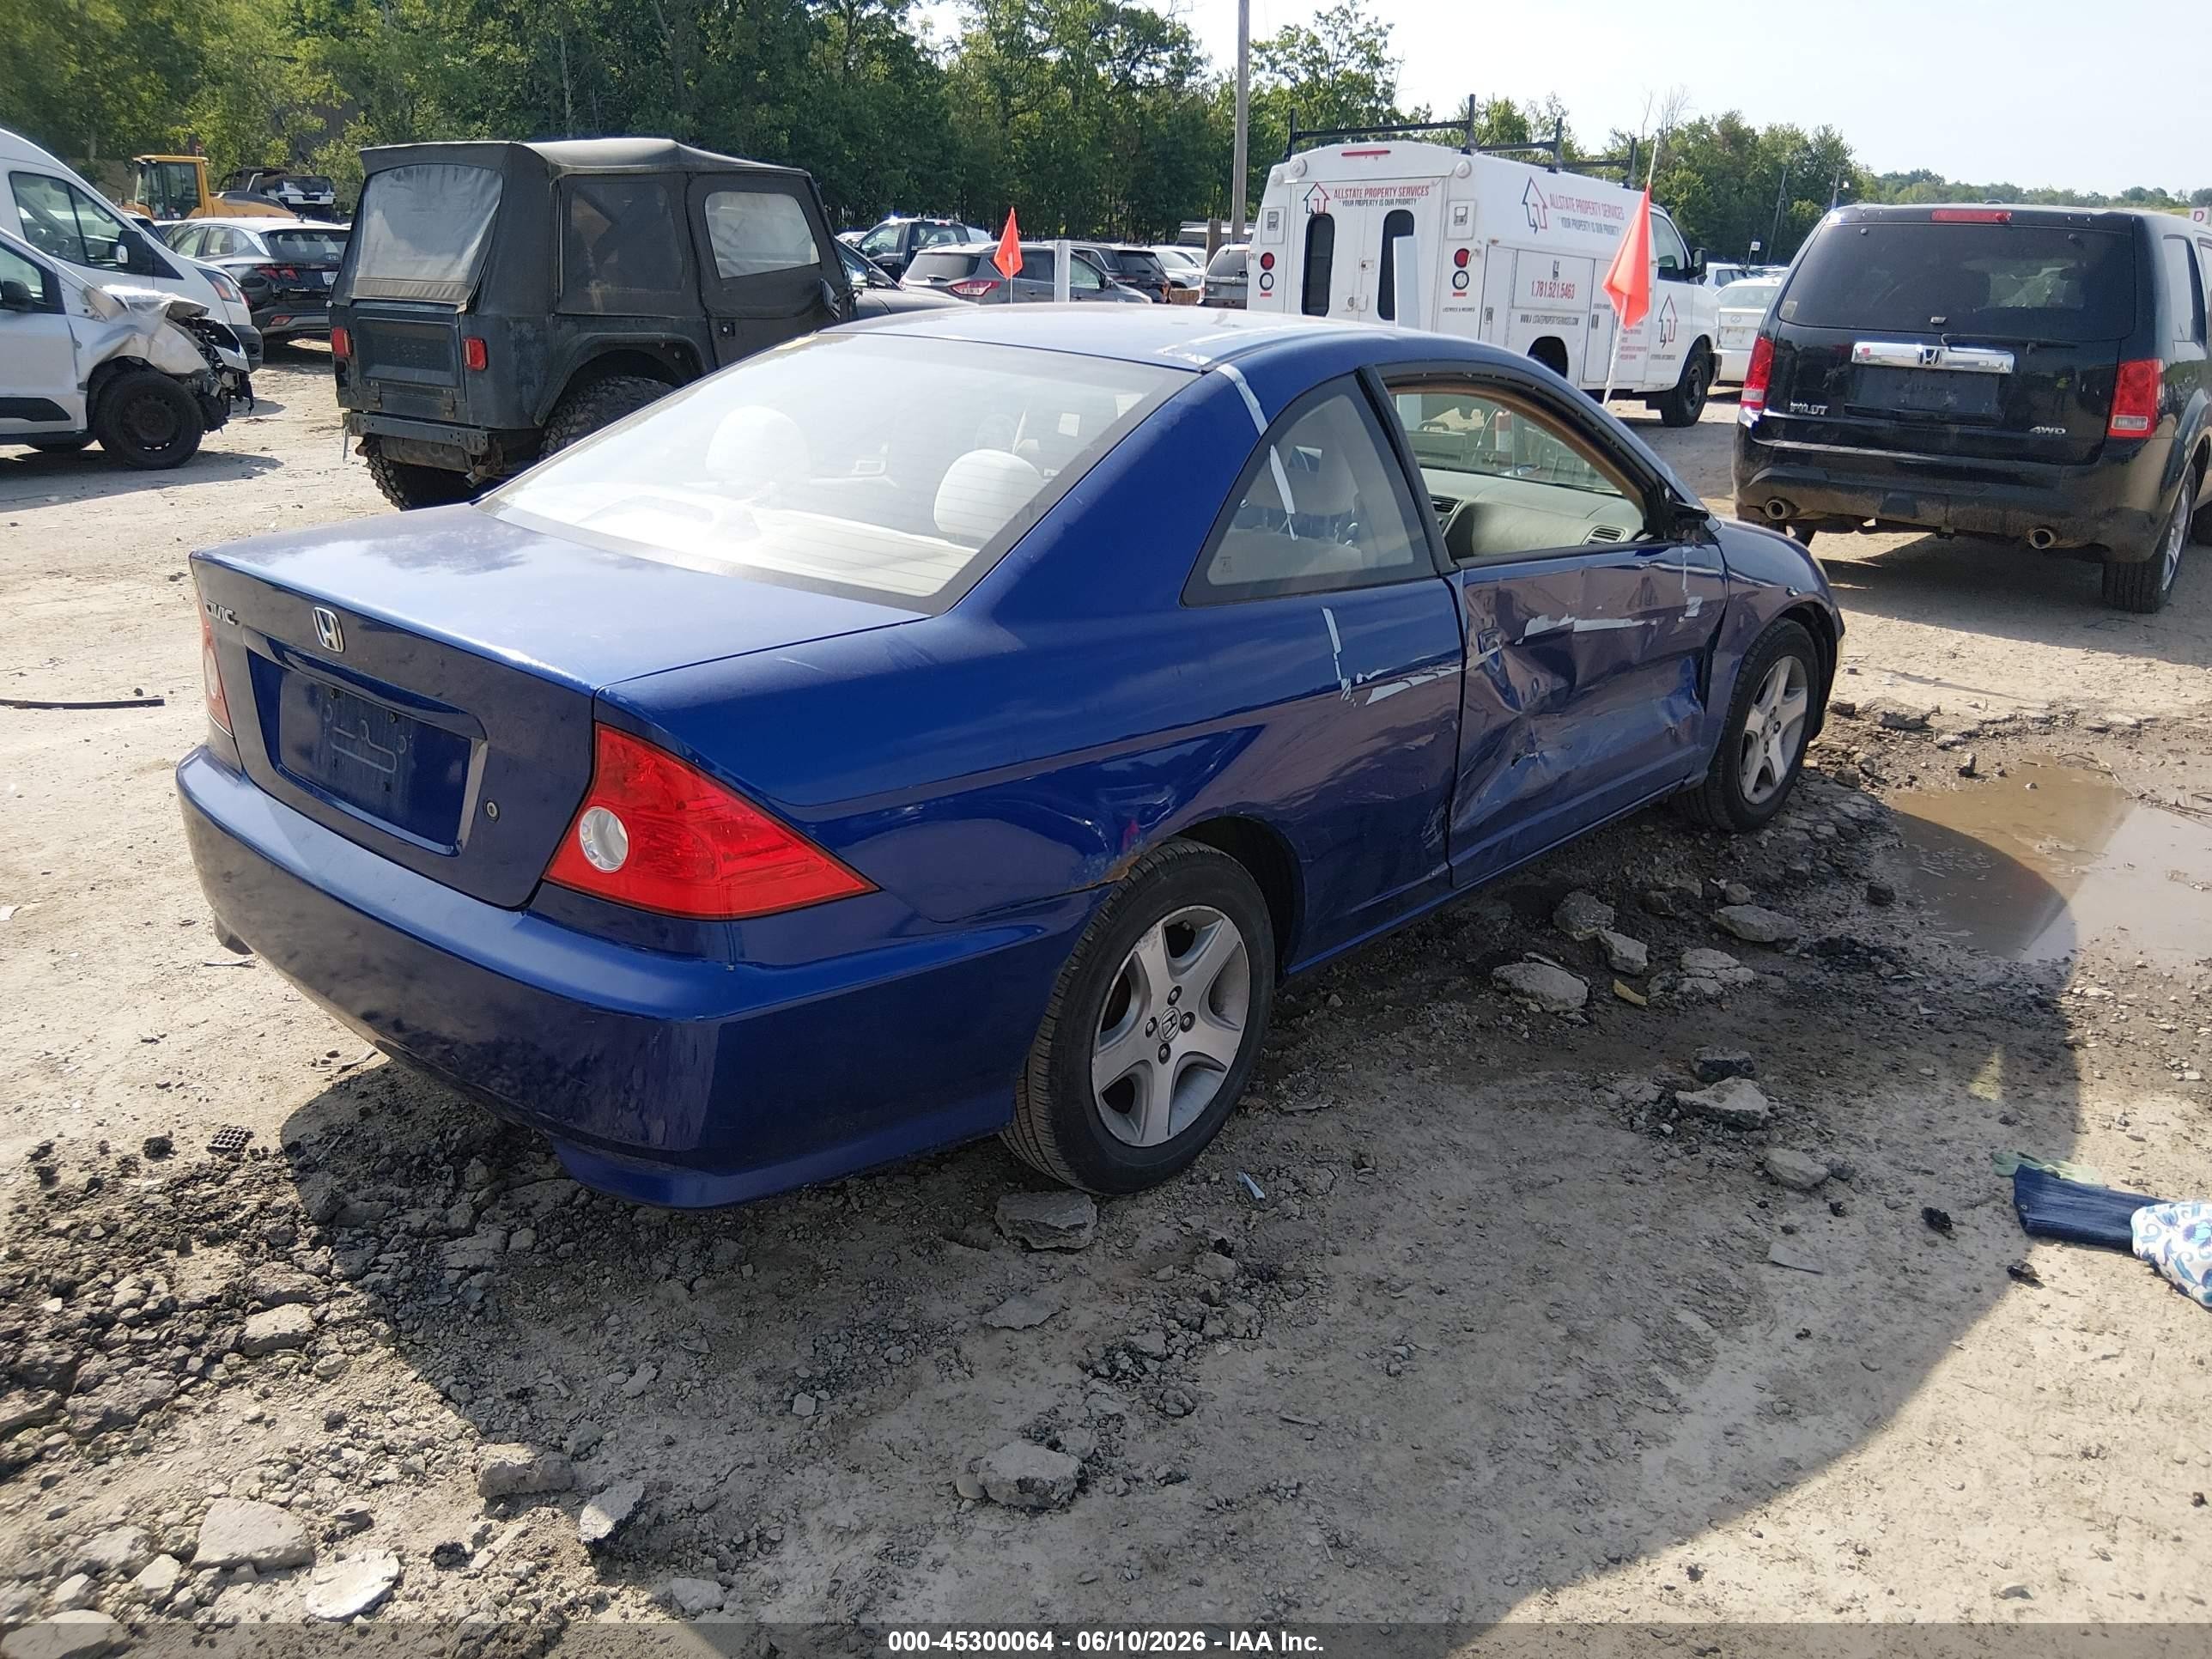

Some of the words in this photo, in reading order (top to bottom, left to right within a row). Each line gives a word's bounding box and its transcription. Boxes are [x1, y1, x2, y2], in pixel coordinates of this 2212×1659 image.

[1334, 188, 1364, 199] ALLSTATE
[1364, 186, 1398, 198] PROPERTY
[1398, 185, 1430, 197] SERVICES
[1354, 198, 1378, 207] PROPERTY
[1378, 198, 1384, 207] IS
[1384, 198, 1395, 206] OUR
[1549, 193, 1576, 213] ALLSTATE
[1576, 198, 1601, 216] PROPERTY
[1601, 203, 1625, 221] SERVICES
[2193, 210, 2205, 222] D
[1531, 281, 1576, 300] 1.781.521.5463
[1790, 402, 1828, 416] PILOT
[2029, 426, 2066, 434] 4WD
[205, 599, 238, 626] CIVIC
